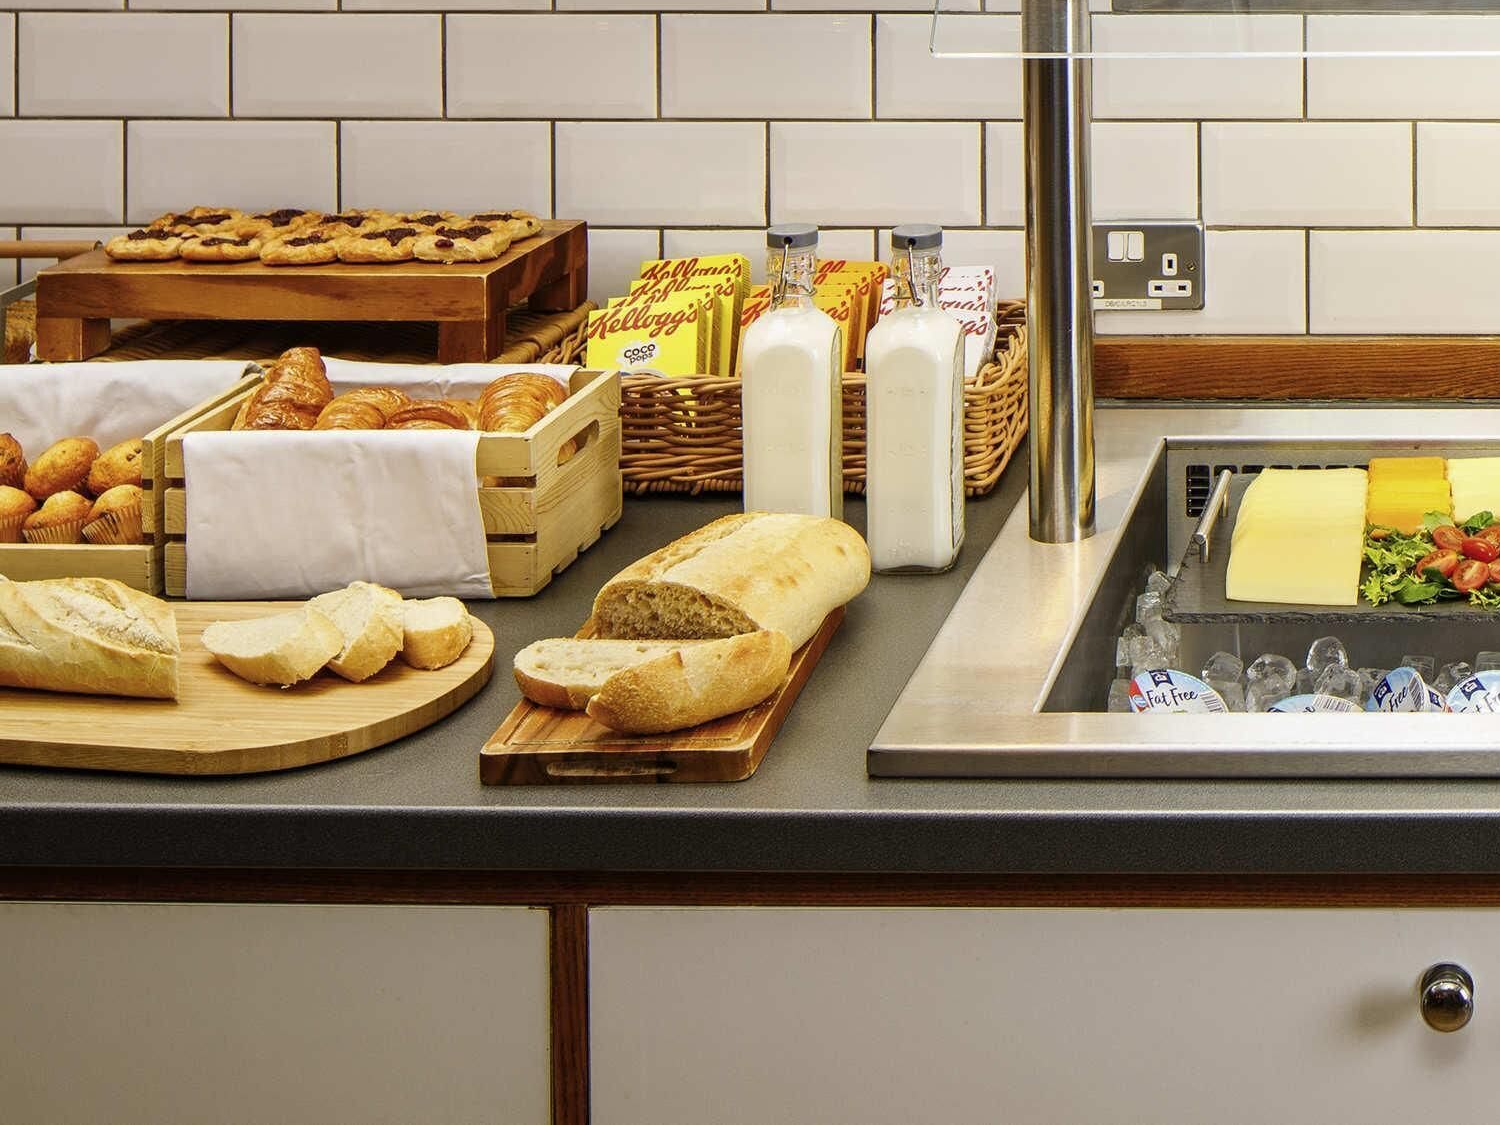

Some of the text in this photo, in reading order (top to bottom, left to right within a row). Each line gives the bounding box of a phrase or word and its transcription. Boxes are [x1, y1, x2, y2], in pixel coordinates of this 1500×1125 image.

[588, 303, 698, 339] Kellogg's
[1146, 687, 1198, 707] Fat Free
